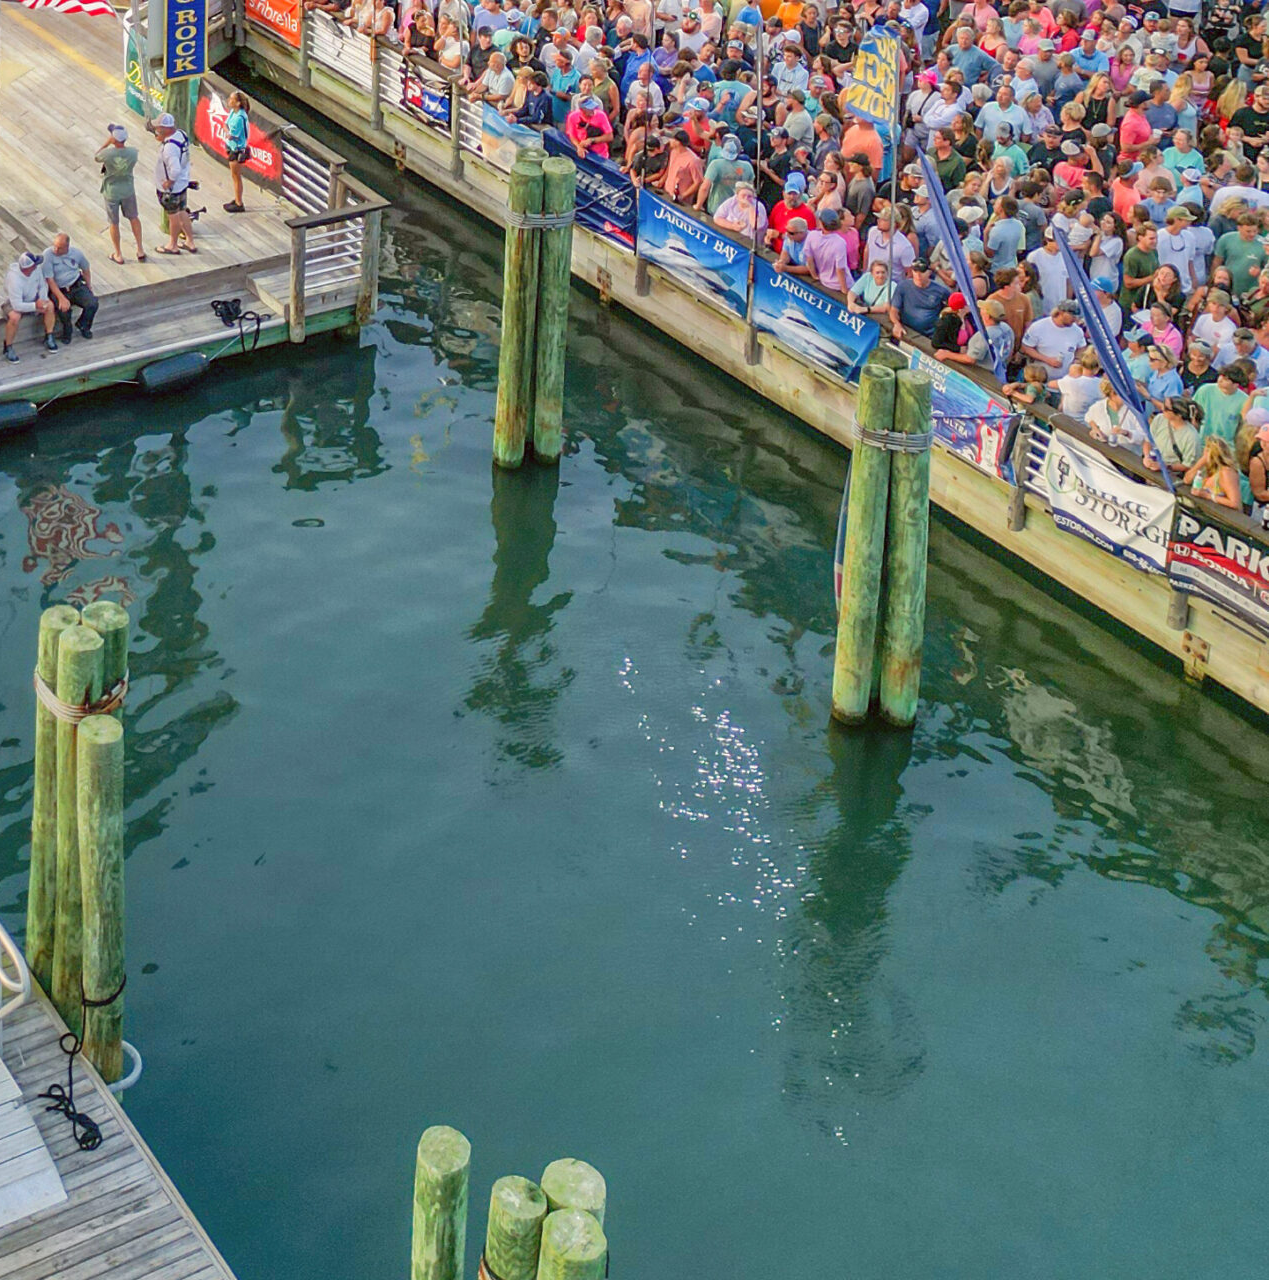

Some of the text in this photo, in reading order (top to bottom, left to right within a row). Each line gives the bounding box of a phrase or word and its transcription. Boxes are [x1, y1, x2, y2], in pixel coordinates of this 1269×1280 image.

[173, 9, 198, 73] ROCK
[250, 145, 273, 166] URES
[654, 206, 739, 264] JARRETT BAY
[770, 274, 866, 336] JARRETT BAY
[1191, 550, 1251, 590] HONDA
